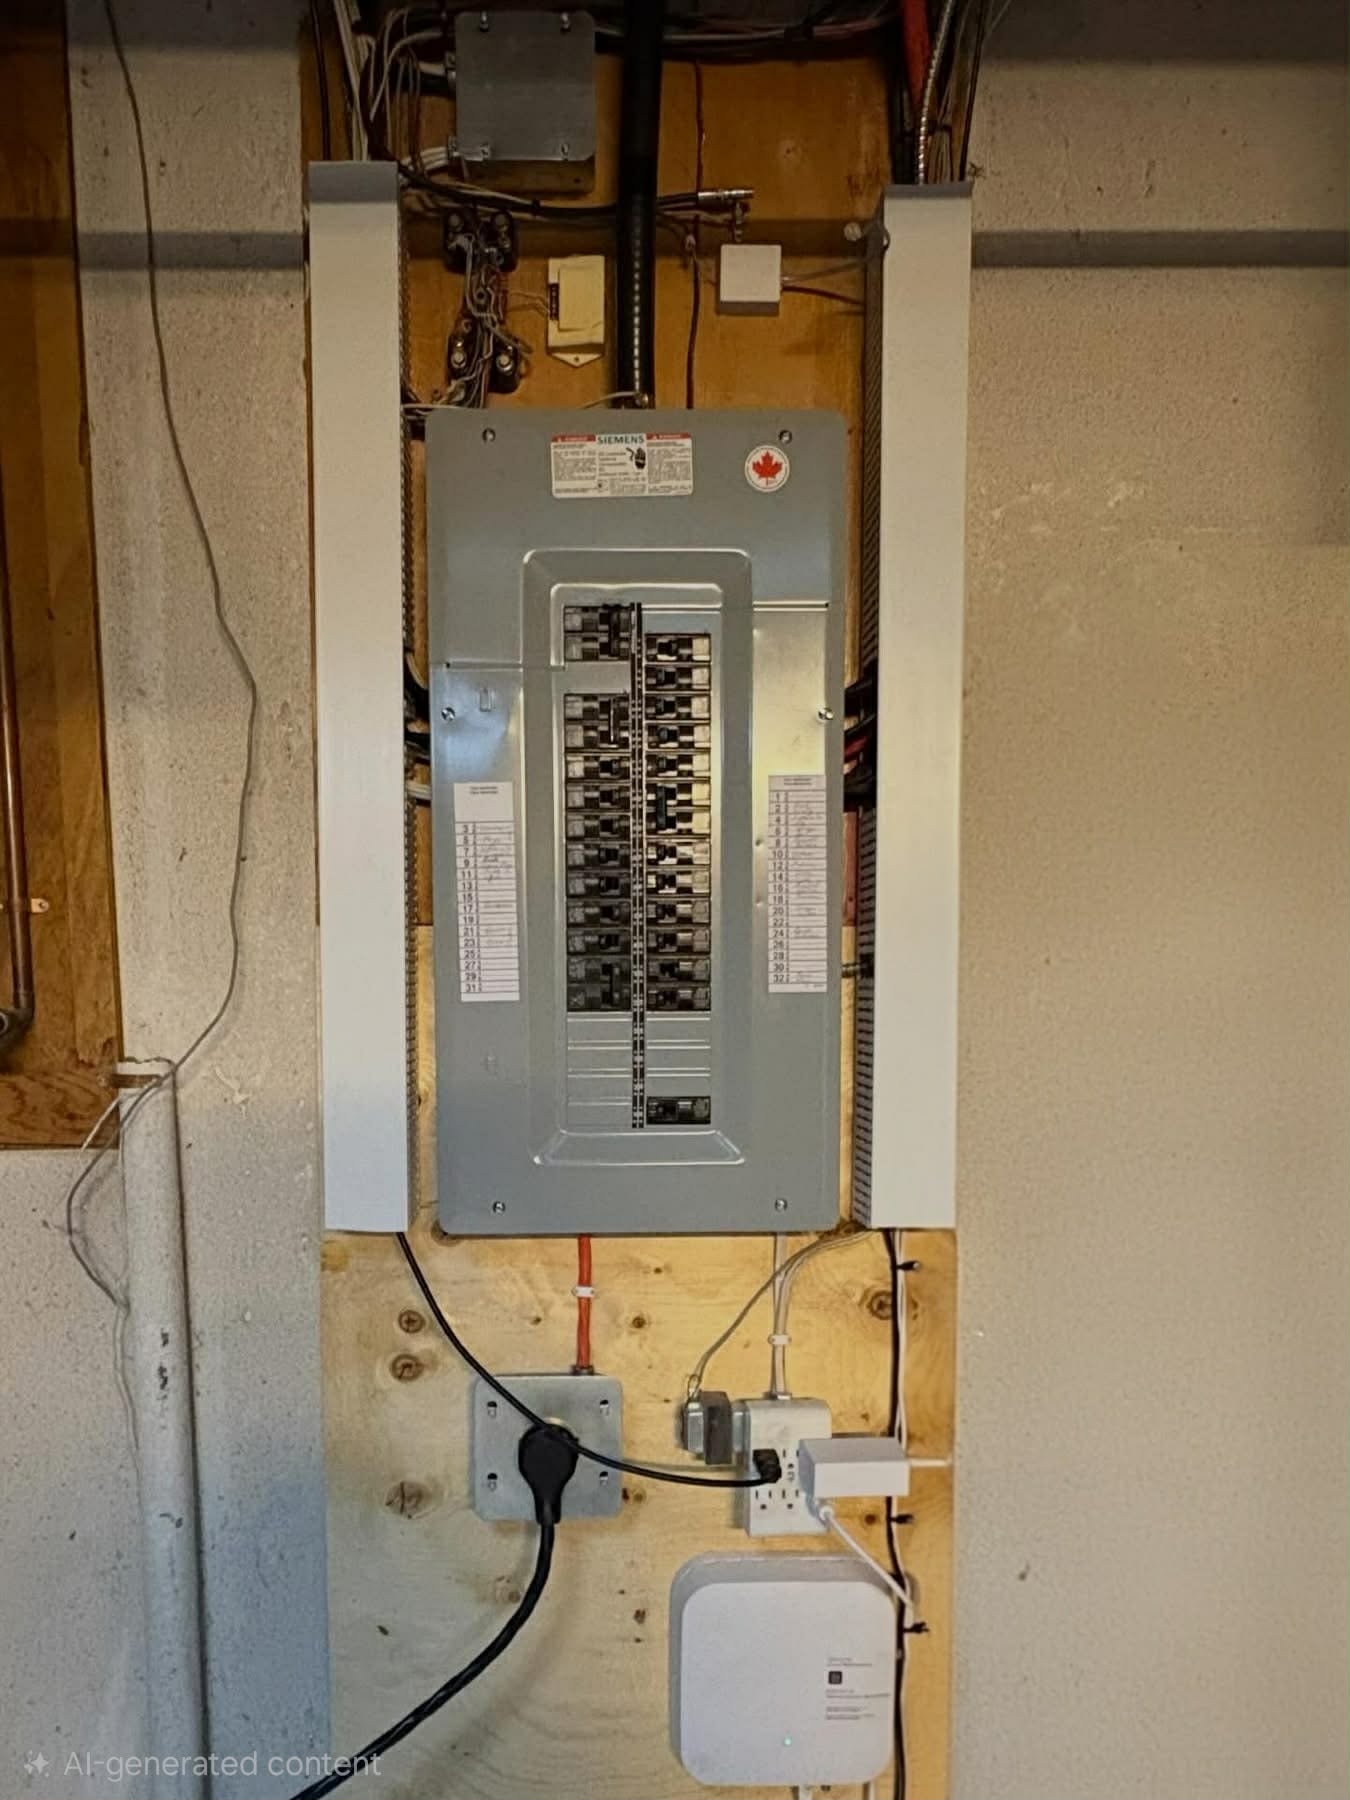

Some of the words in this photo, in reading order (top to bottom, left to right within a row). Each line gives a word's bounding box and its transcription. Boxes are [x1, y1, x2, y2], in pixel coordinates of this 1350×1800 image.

[597, 435, 645, 445] SIEMENS
[772, 849, 784, 859] 10
[462, 870, 471, 879] 11
[463, 904, 473, 914] 17
